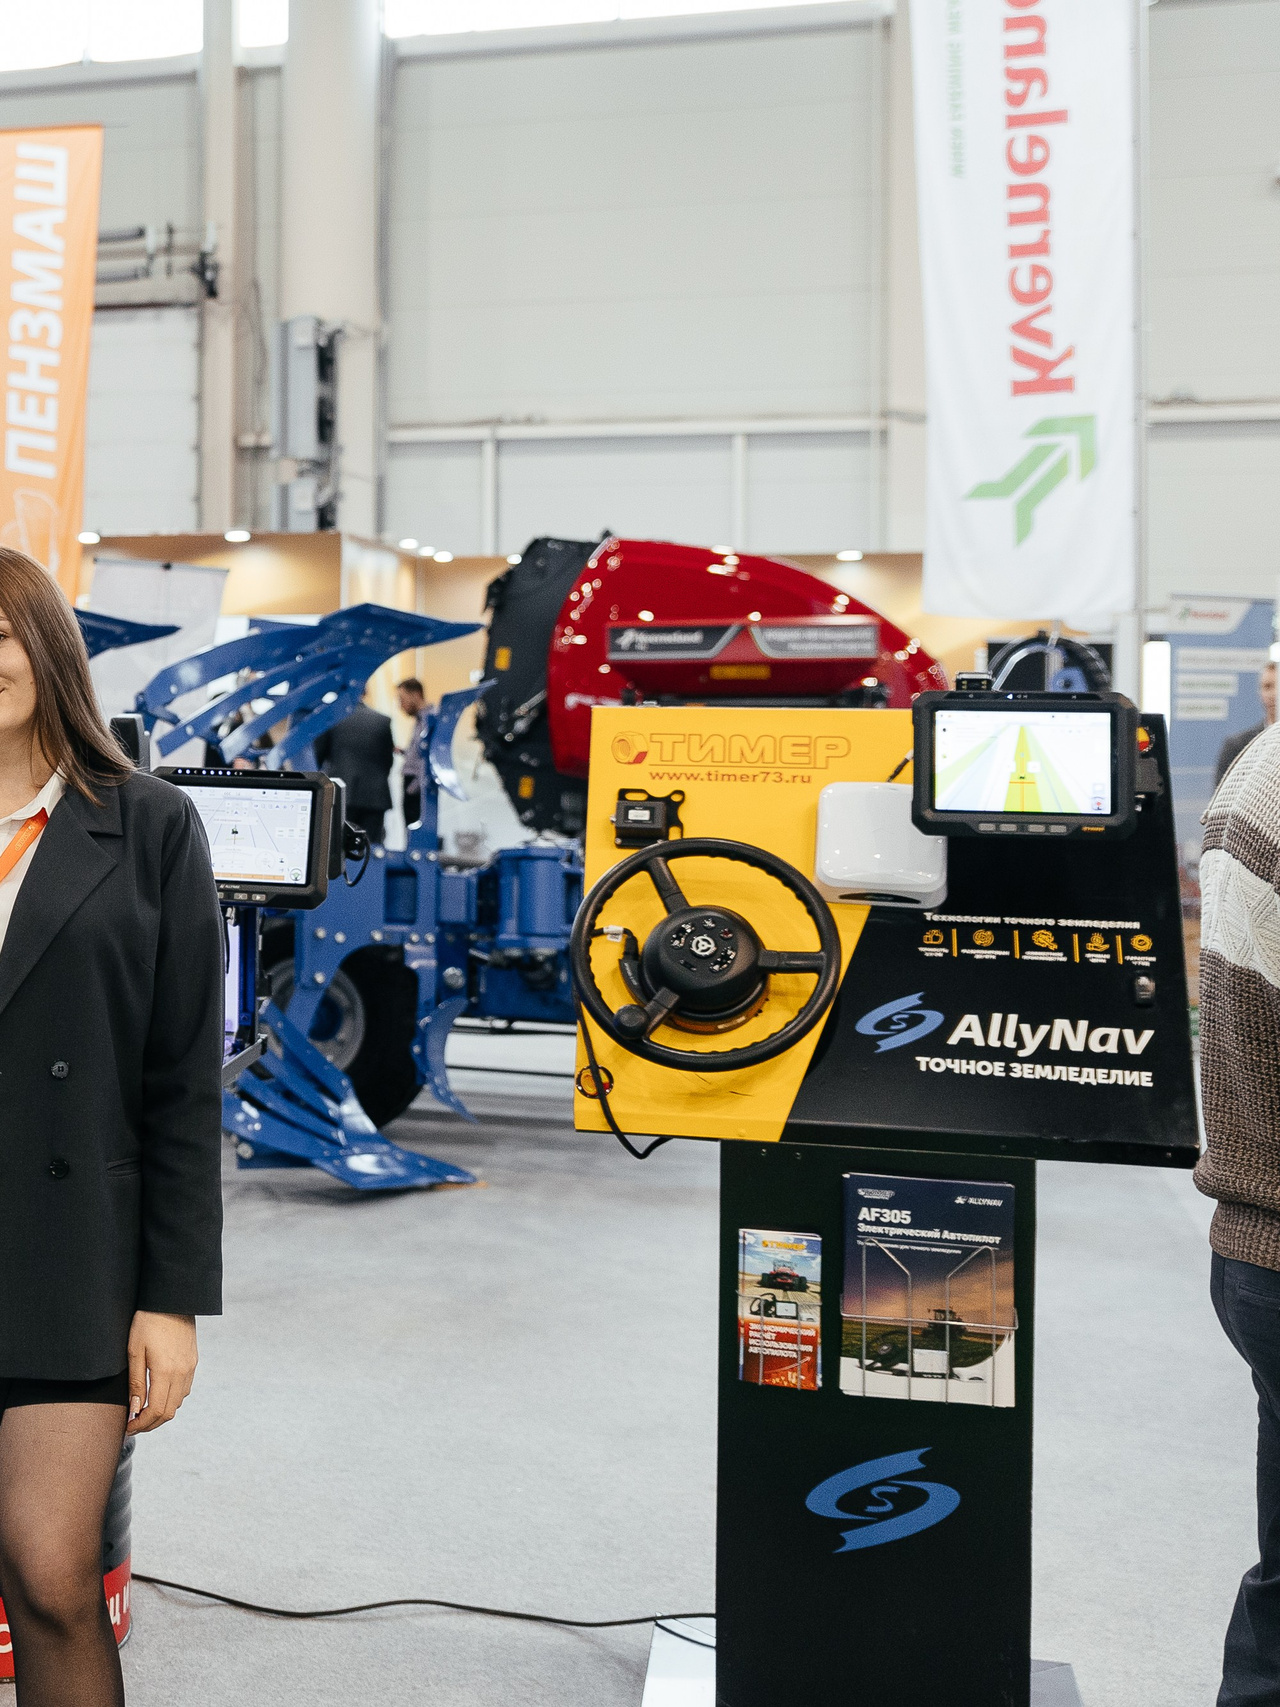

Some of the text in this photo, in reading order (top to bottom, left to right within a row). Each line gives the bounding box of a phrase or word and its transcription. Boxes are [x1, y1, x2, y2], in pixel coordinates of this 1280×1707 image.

[4, 143, 69, 479] ПЕНЗМАШ
[649, 733, 852, 769] ТИМЕР
[649, 771, 812, 784] www.timer73.ru
[923, 912, 1140, 929] Технологии точного земледелия
[947, 1013, 1155, 1057] AllyNav
[915, 1056, 1154, 1087] ТОЧНОЕ ЗЕМЛЕДЕЛИЕ
[857, 1207, 912, 1224] AF305
[857, 1223, 1001, 1244] Электрический Автопилот
